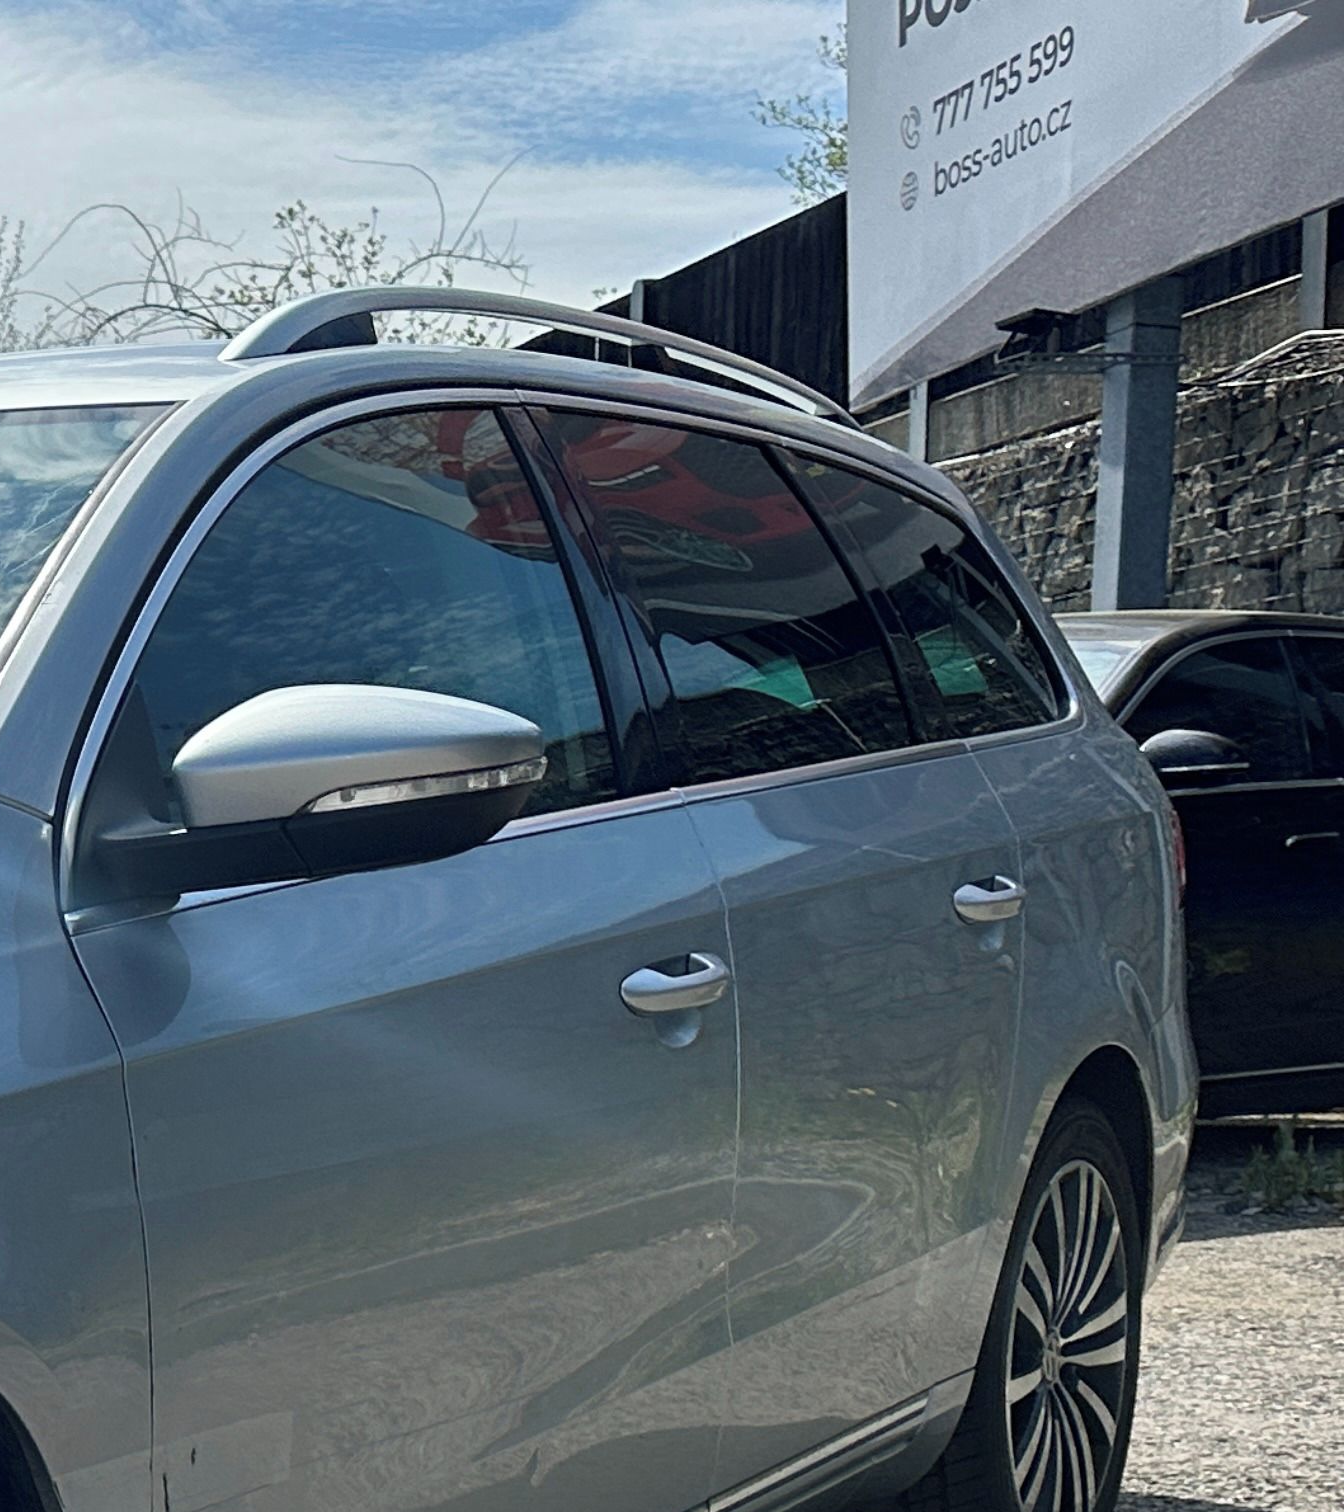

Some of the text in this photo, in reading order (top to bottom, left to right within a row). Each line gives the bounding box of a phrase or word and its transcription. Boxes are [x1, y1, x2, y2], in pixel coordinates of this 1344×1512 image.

[933, 26, 1074, 135] 777 755 599
[934, 100, 1072, 196] boss-auto.cz
